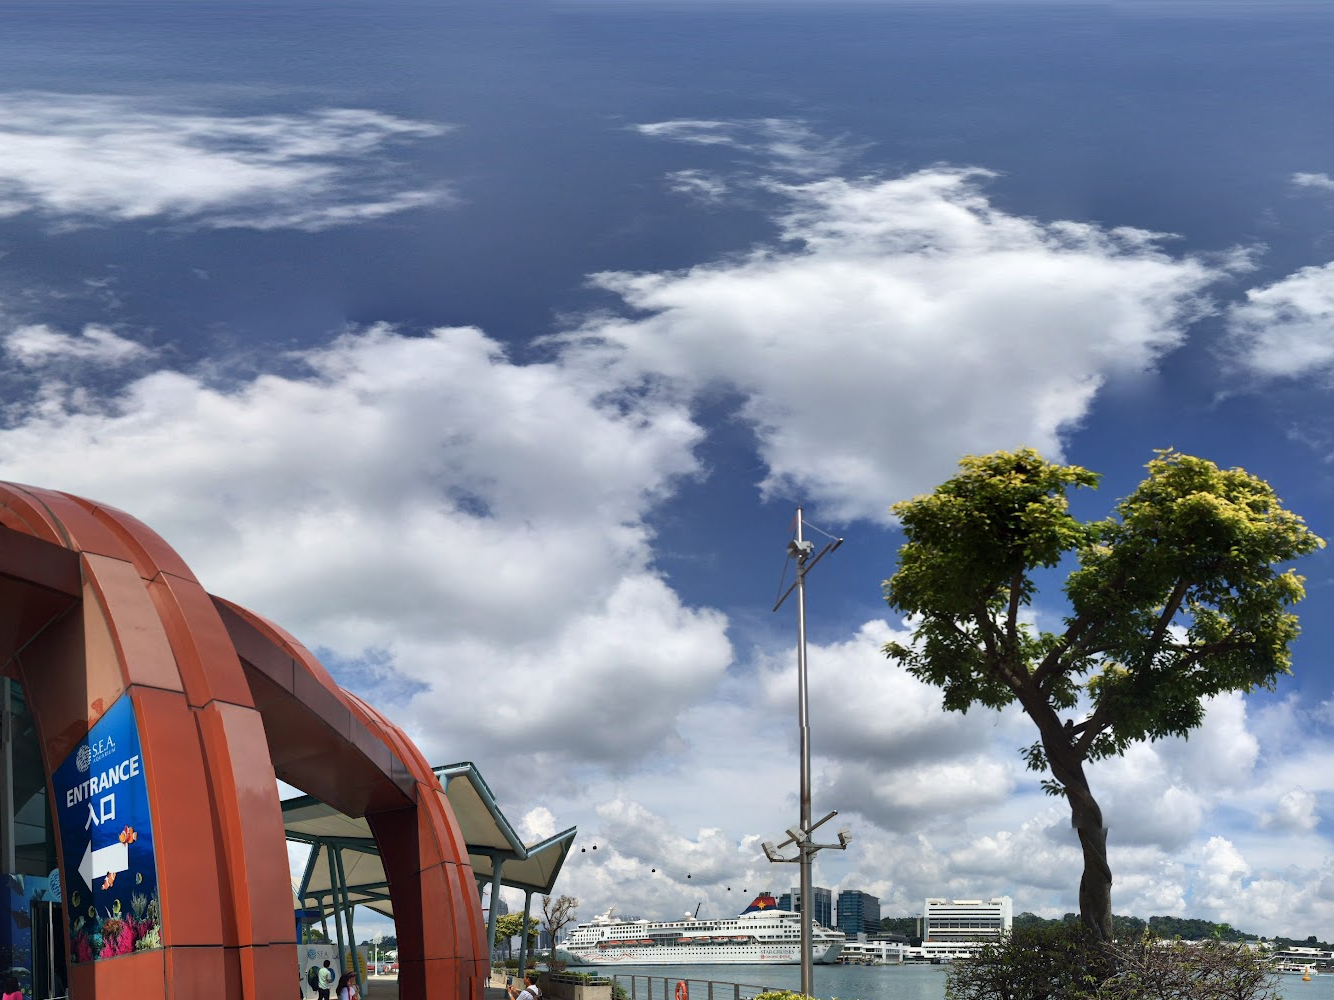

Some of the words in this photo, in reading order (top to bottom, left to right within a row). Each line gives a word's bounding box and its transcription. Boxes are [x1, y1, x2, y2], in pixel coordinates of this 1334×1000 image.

[92, 735, 116, 757] S.E.A.
[93, 747, 116, 763] AQUARIUM
[67, 755, 139, 808] ENTRANCE
[85, 793, 115, 831] 入口
